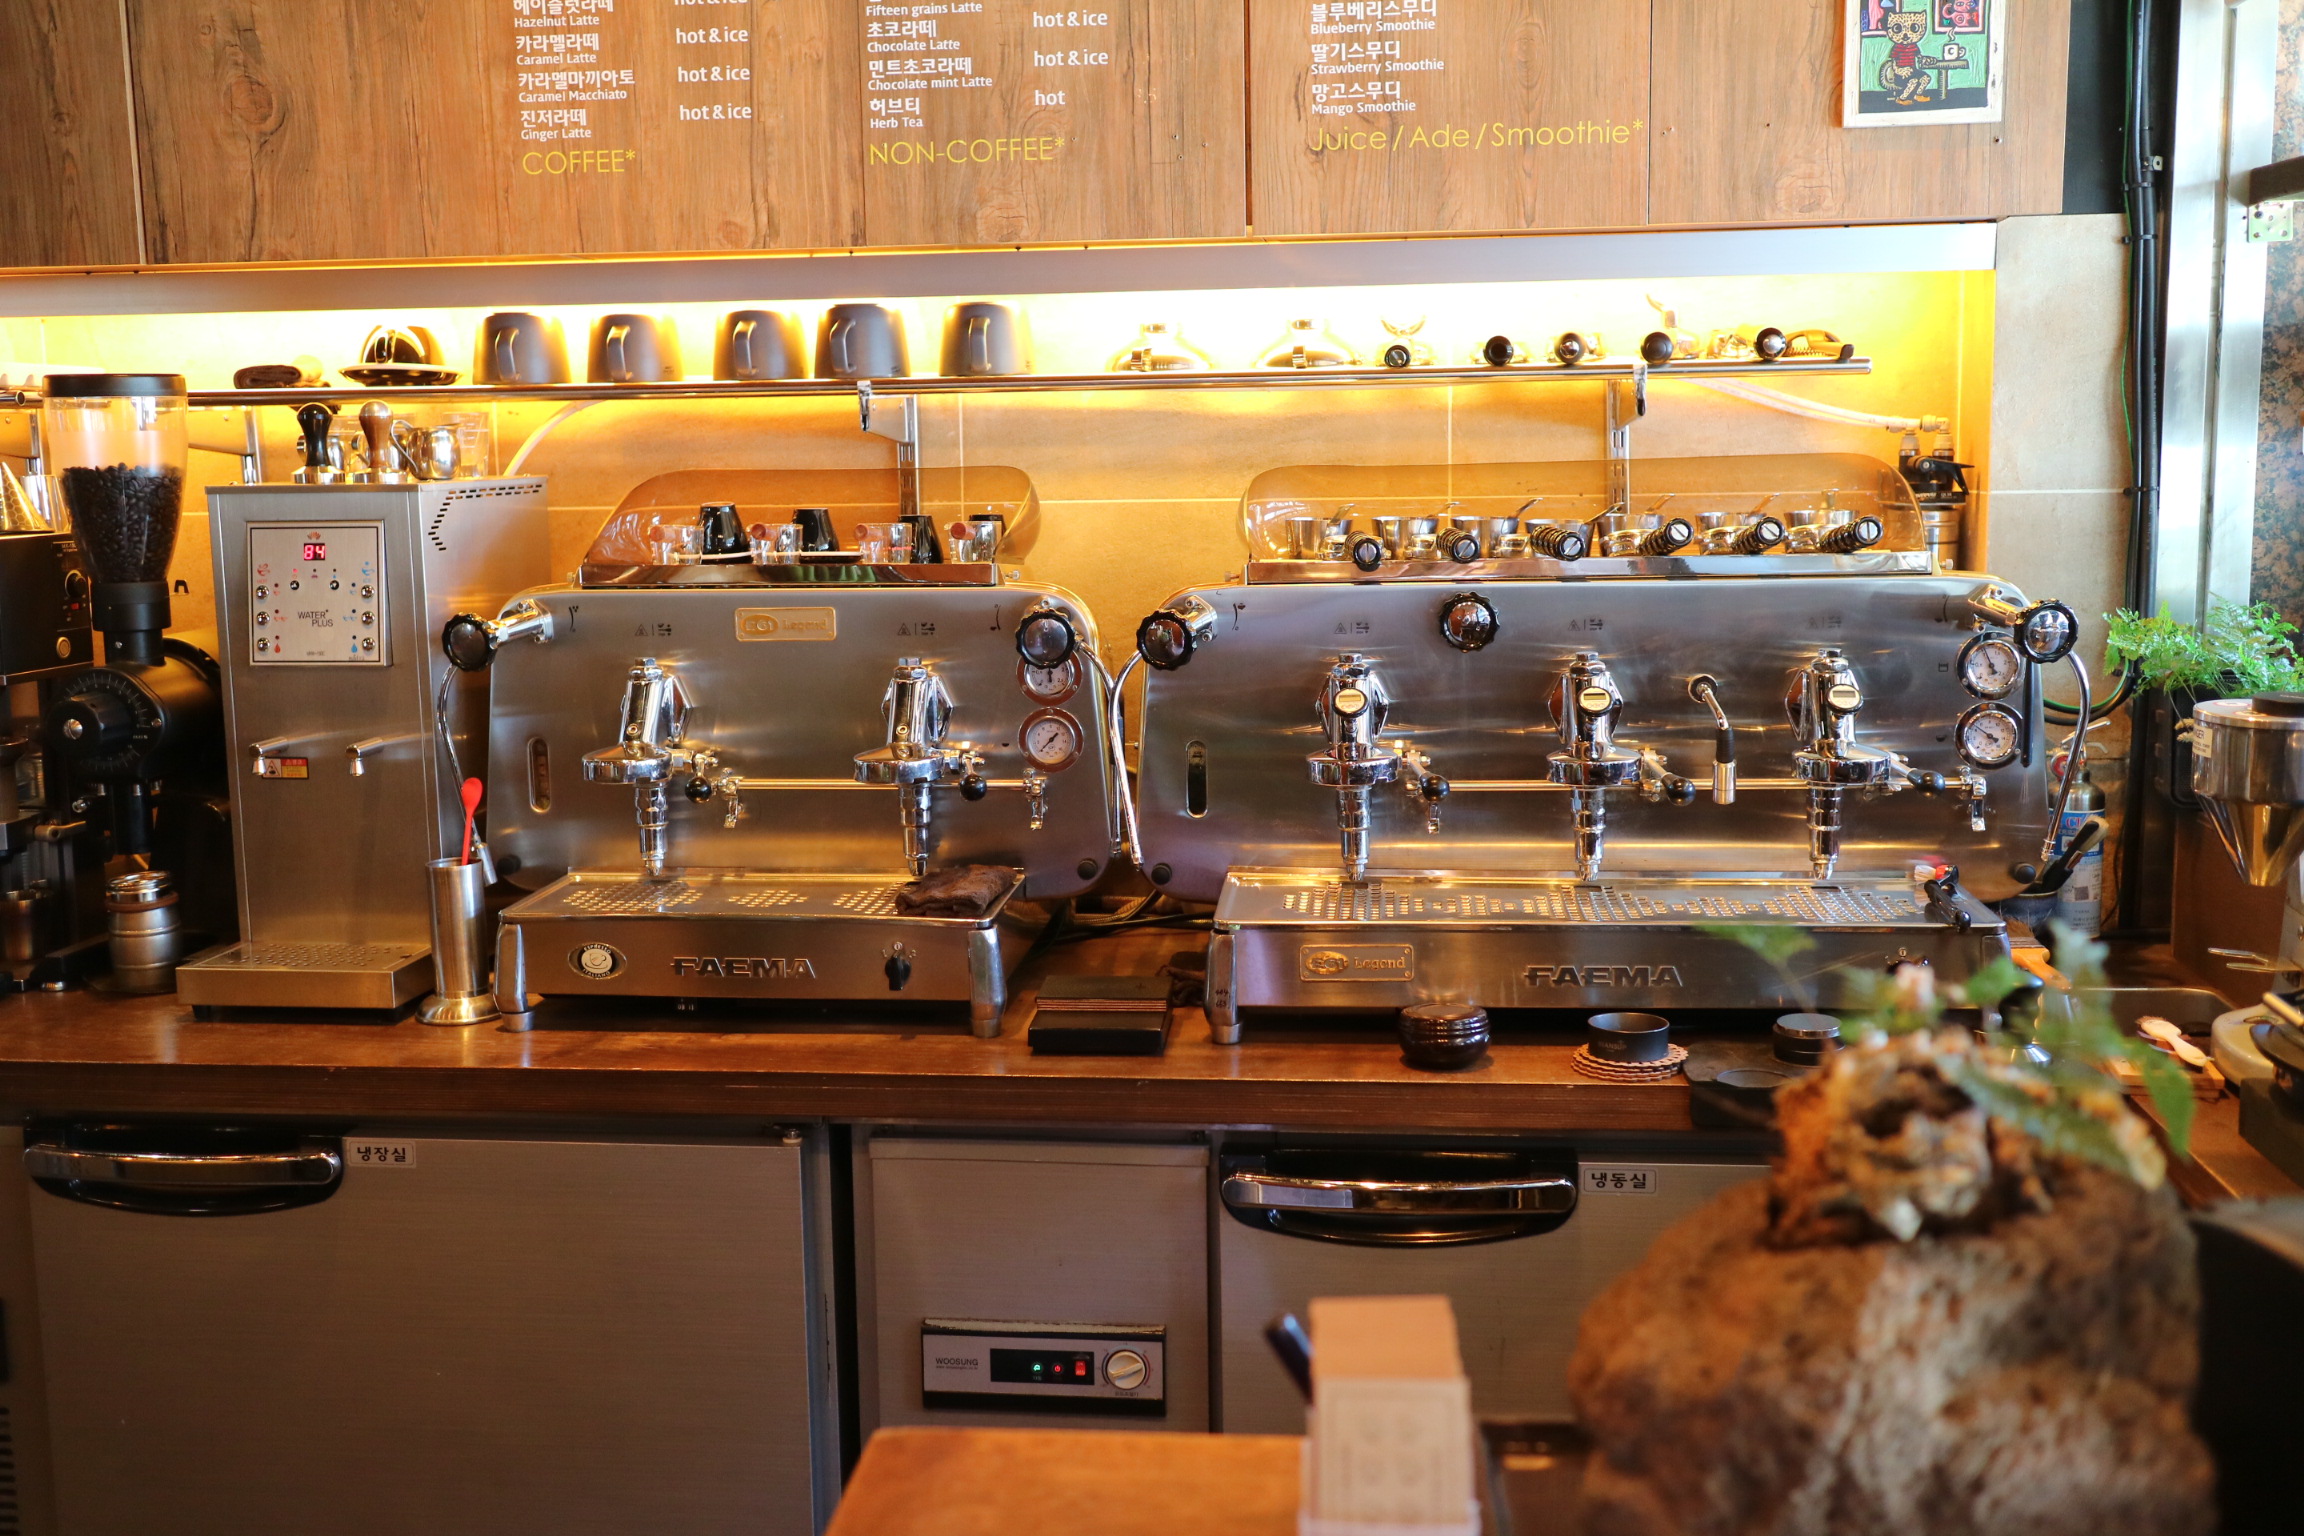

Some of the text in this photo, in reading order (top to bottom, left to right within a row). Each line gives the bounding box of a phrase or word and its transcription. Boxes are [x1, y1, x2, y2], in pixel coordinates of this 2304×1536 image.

[866, 2, 983, 17] Fifteen grains Latte
[1310, 0, 1437, 22] 블루베리스무디
[514, 15, 600, 28] Hazelnut Latte
[867, 19, 937, 38] 초코라떼
[1310, 18, 1436, 35] Blueberry Smoothie
[516, 33, 600, 53] 카라멜라떼
[867, 40, 961, 53] Chocolate Latte
[1311, 40, 1401, 63] 딸기스무디
[516, 53, 597, 66] Caramel Latte
[868, 57, 972, 79] 민트초코라떼
[1311, 58, 1445, 75] Strawberry Smoothie
[518, 69, 635, 91] 카라멜마끼아토
[867, 77, 993, 91] Chocolate mint Latte
[518, 88, 627, 103] Caramel Macchiato
[1034, 89, 1066, 106] hot
[1311, 81, 1401, 103] 망고스무디
[869, 97, 920, 117] 허브티
[1311, 99, 1417, 116] Mango Smoothie
[520, 108, 587, 128] 진저라떼
[870, 116, 924, 129] Herb Tea
[520, 128, 592, 142] Ginger Latte
[303, 544, 326, 560] 84
[298, 611, 326, 619] WATER
[312, 619, 333, 627] PLUS
[670, 956, 817, 978] FAEMA
[1354, 957, 1406, 970] Legend
[1523, 965, 1683, 987] FAEMA
[357, 1146, 406, 1162] 냉장실
[1591, 1172, 1646, 1189] 냉동실
[935, 1357, 979, 1366] WOOSUNG
